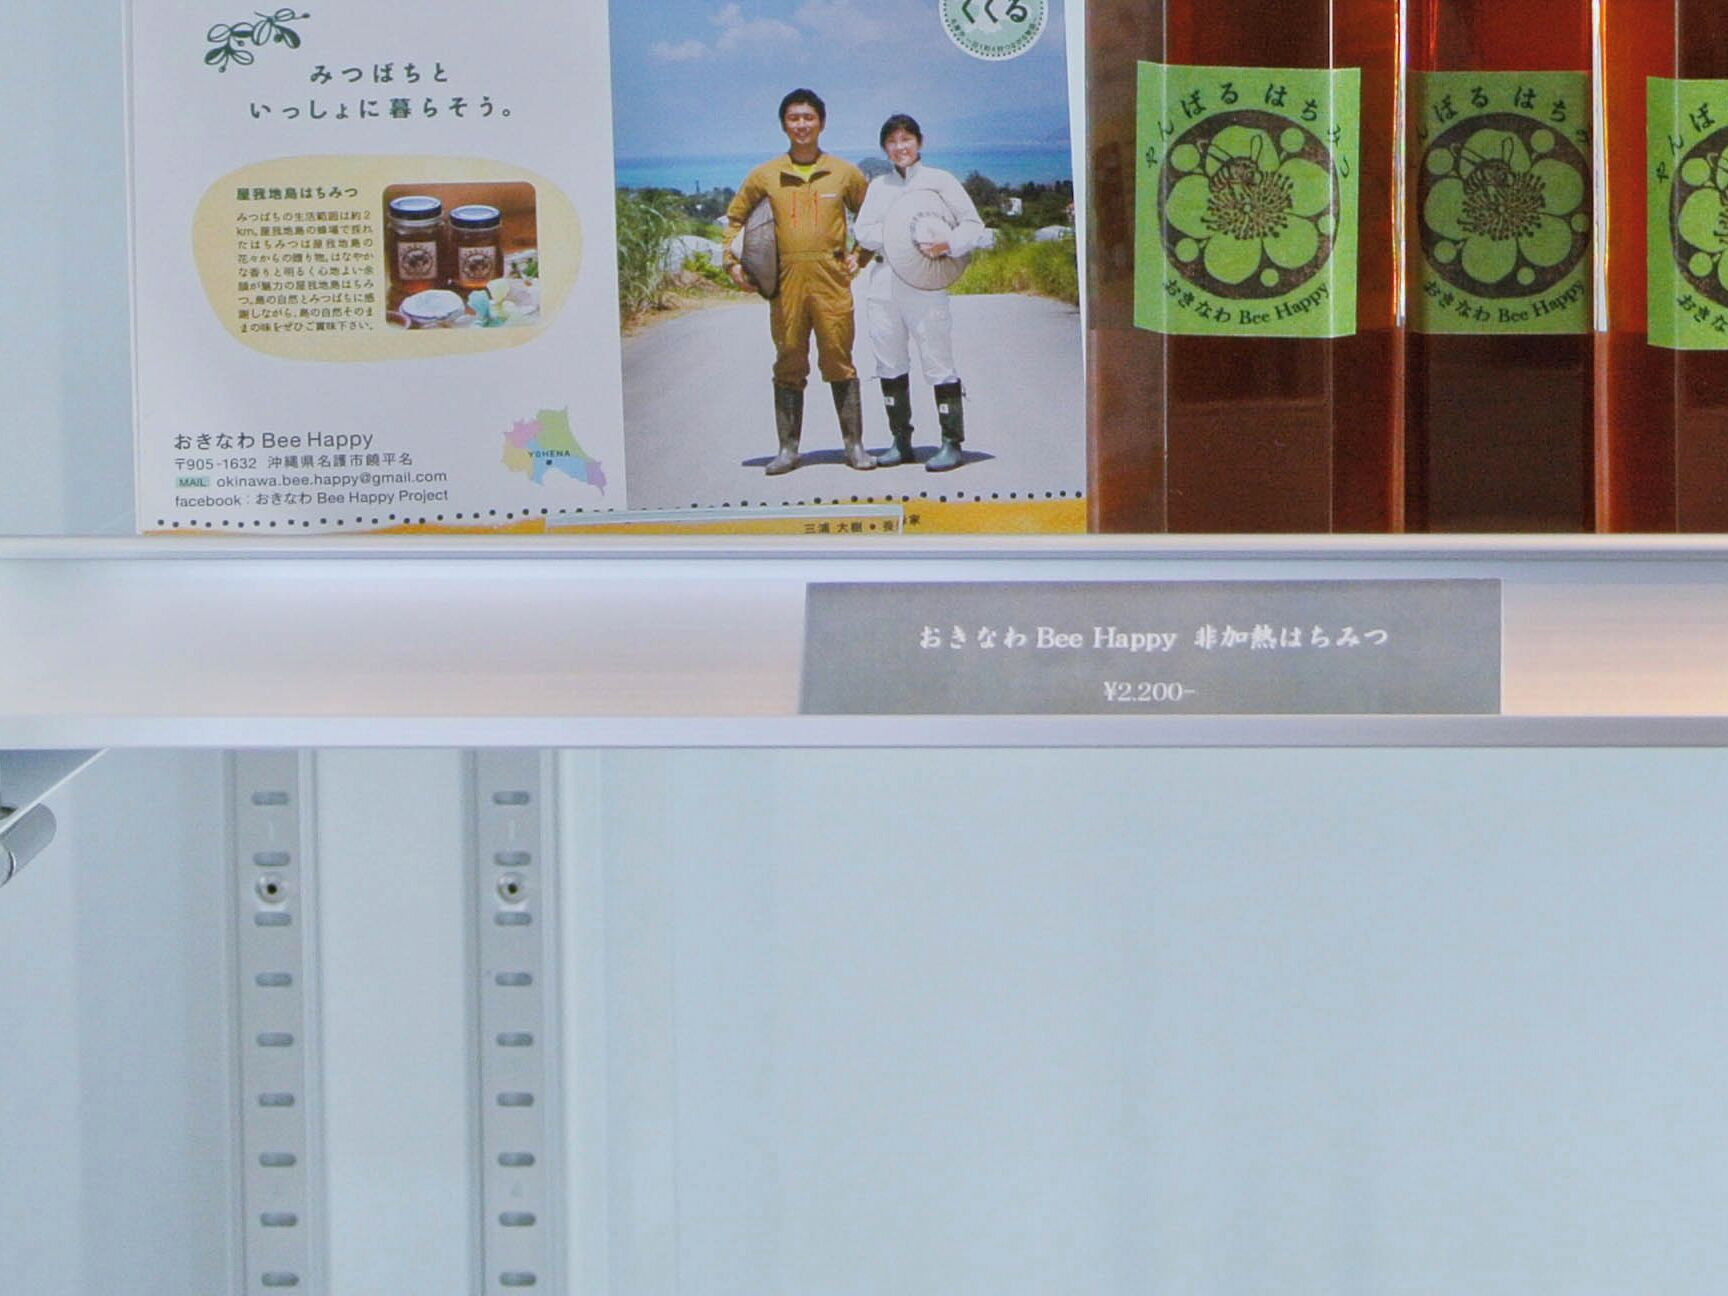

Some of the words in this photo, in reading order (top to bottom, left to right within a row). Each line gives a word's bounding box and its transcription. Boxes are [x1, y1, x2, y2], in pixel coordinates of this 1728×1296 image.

[310, 62, 449, 84] みつばちと
[250, 96, 512, 120] いっしょに暮らそう。
[1163, 278, 1231, 324] おきなわ
[1239, 309, 1270, 325] Bee
[1275, 282, 1330, 321] Happy
[1499, 308, 1528, 323] Bee
[1532, 280, 1585, 319] Happy
[174, 433, 255, 450] おきなわ
[261, 433, 301, 449] Bee
[307, 431, 373, 450] Happy
[178, 478, 206, 487] MAIL
[217, 472, 448, 488] okinawa.bee.happy@gmail.com
[256, 493, 313, 505] おきなわ
[317, 492, 345, 504] Bee
[349, 491, 395, 505] Happy
[399, 489, 448, 504] Project
[919, 625, 1027, 650] おきなわ
[1037, 627, 1083, 649] Bee
[1093, 626, 1178, 652] Happy
[1194, 623, 1389, 650] 非加熱はちみつ
